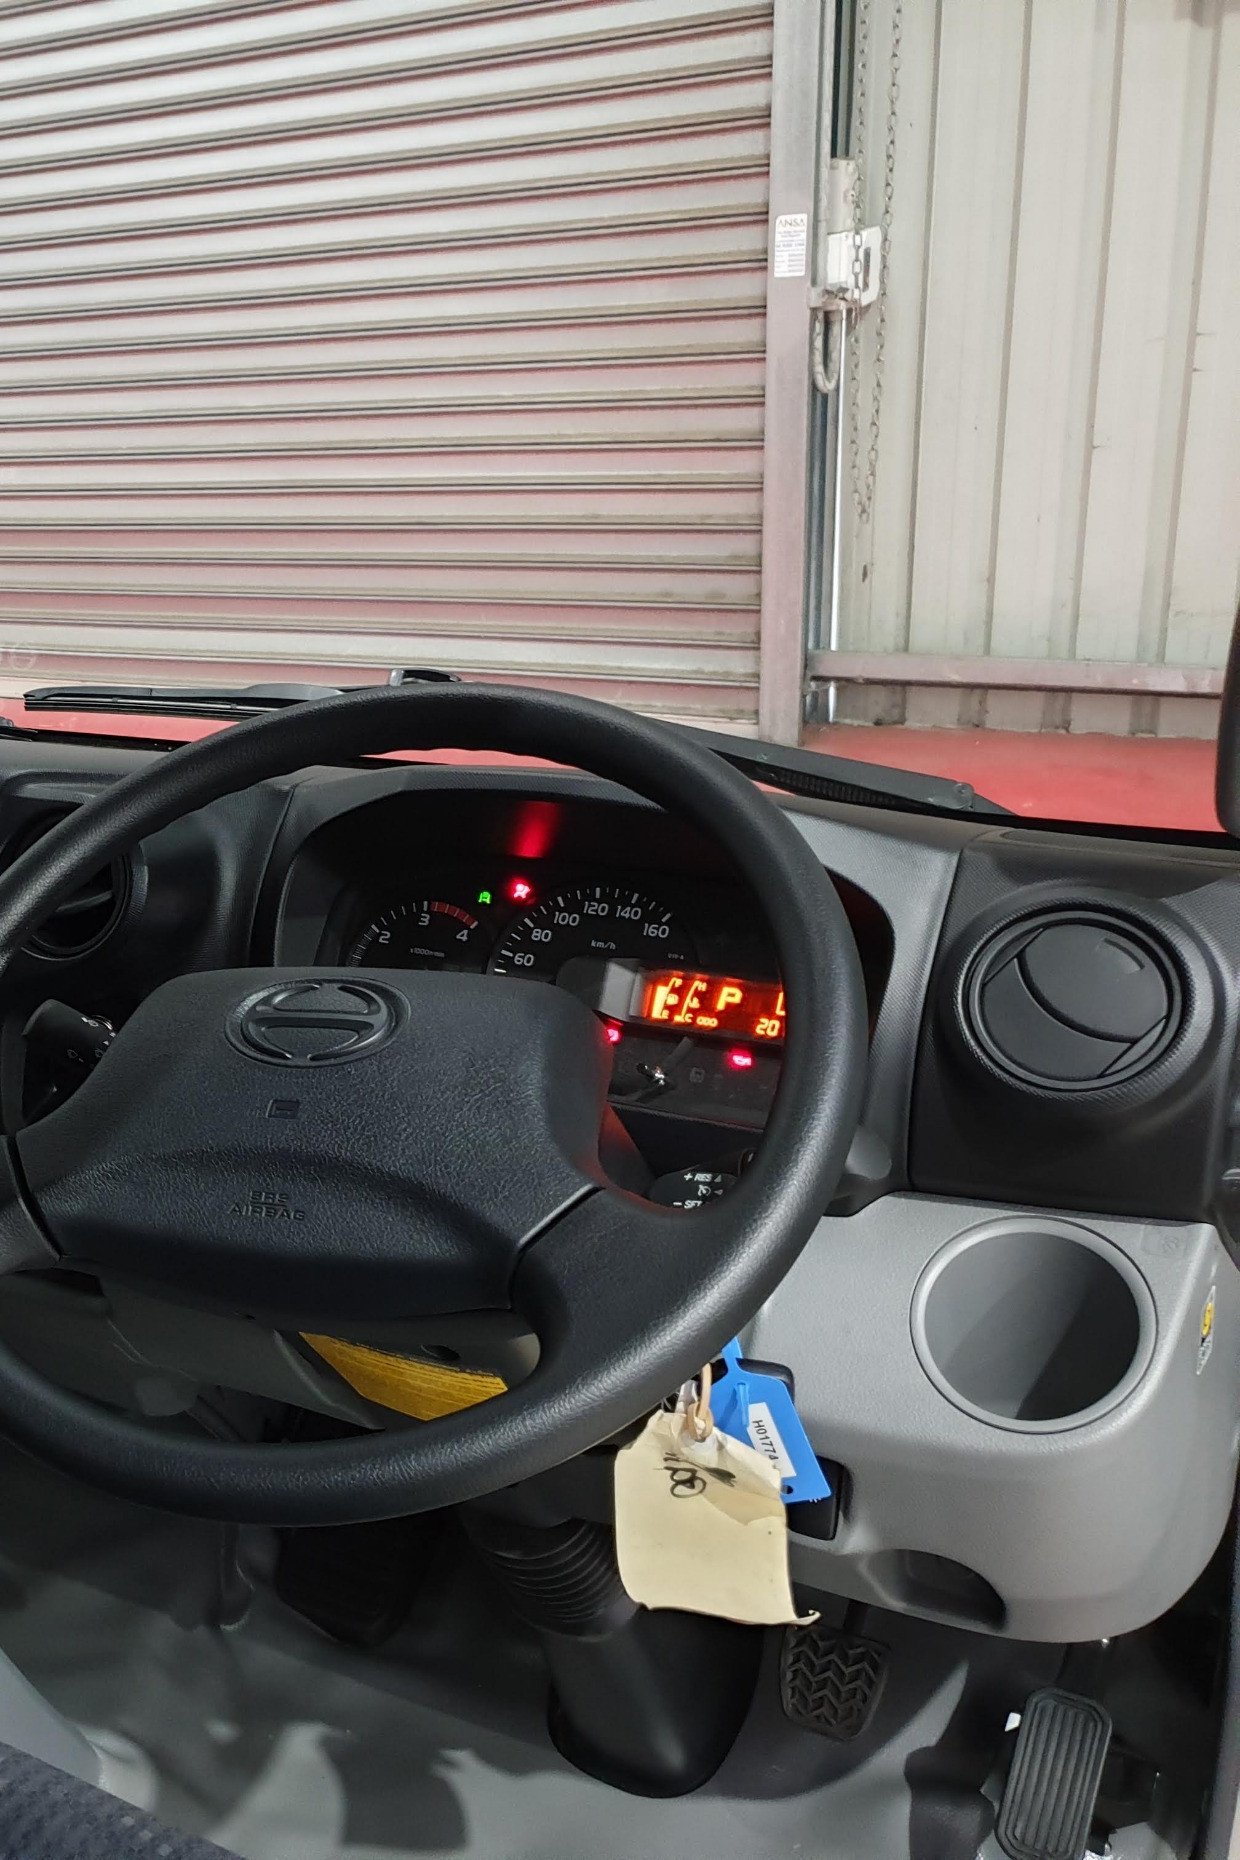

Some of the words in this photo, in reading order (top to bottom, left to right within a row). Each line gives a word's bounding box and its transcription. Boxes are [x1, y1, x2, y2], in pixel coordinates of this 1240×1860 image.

[583, 901, 609, 916] 120
[615, 905, 642, 920] 140
[418, 913, 431, 926] 3
[553, 911, 580, 926] 100
[378, 931, 391, 944] 2
[455, 929, 469, 942] 4
[531, 927, 552, 942] 80
[643, 923, 670, 938] 160
[590, 939, 616, 950] km/h
[514, 953, 534, 967] 60
[716, 986, 743, 1011] P
[694, 1173, 713, 1182] RES
[228, 1204, 306, 1221] AIRBAG
